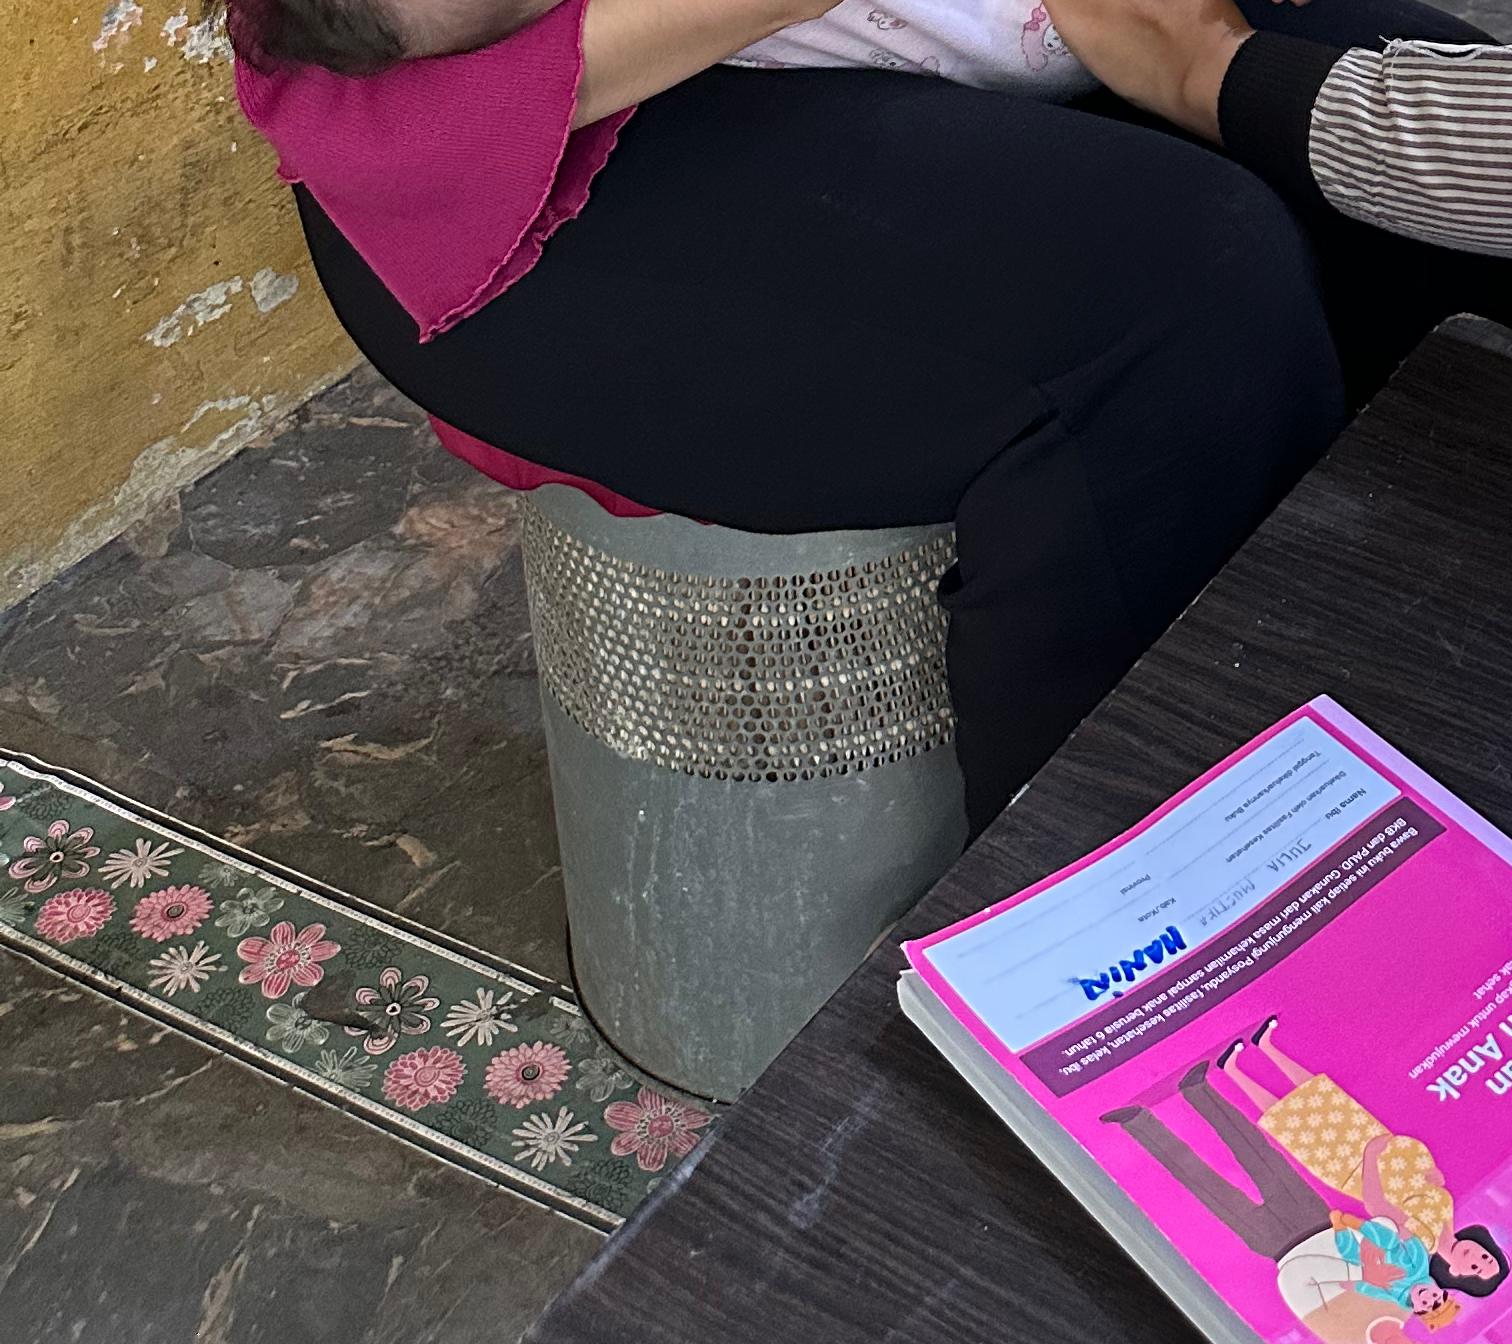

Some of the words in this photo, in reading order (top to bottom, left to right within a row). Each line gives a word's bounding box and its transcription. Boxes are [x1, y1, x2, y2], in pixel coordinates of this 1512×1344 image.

[1339, 787, 1367, 808] Nama
[1384, 817, 1407, 836] BKB
[1389, 826, 1419, 849] Bawa
[1225, 833, 1265, 863] Kesehatan
[1366, 832, 1386, 850] dan
[1338, 846, 1370, 871] PAUD.
[1367, 846, 1394, 867] buku
[1355, 864, 1372, 878] ini
[1298, 869, 1341, 904] Gunakan
[1327, 874, 1357, 899] setiap
[1279, 901, 1300, 920] dari
[1310, 896, 1332, 914] kali
[1251, 910, 1312, 960] mengunjungi
[1252, 915, 1282, 939] masa
[1203, 936, 1256, 973] kehamilan
[1167, 969, 1205, 998] sampai
[1200, 956, 1254, 991] Posyandu,
[1472, 973, 1502, 1000] sehat
[1141, 992, 1168, 1012] anak
[1162, 989, 1205, 1017] fasilitas
[1103, 1008, 1145, 1034] berusia
[1467, 1002, 1497, 1028] untuk
[1095, 1031, 1106, 1041] 6
[1107, 1014, 1166, 1048] kesehatan,
[1061, 1036, 1098, 1057] tahun.
[1080, 1045, 1112, 1066] kelas
[1408, 1025, 1470, 1079] mewujudkan
[1427, 1034, 1502, 1101] Anak
